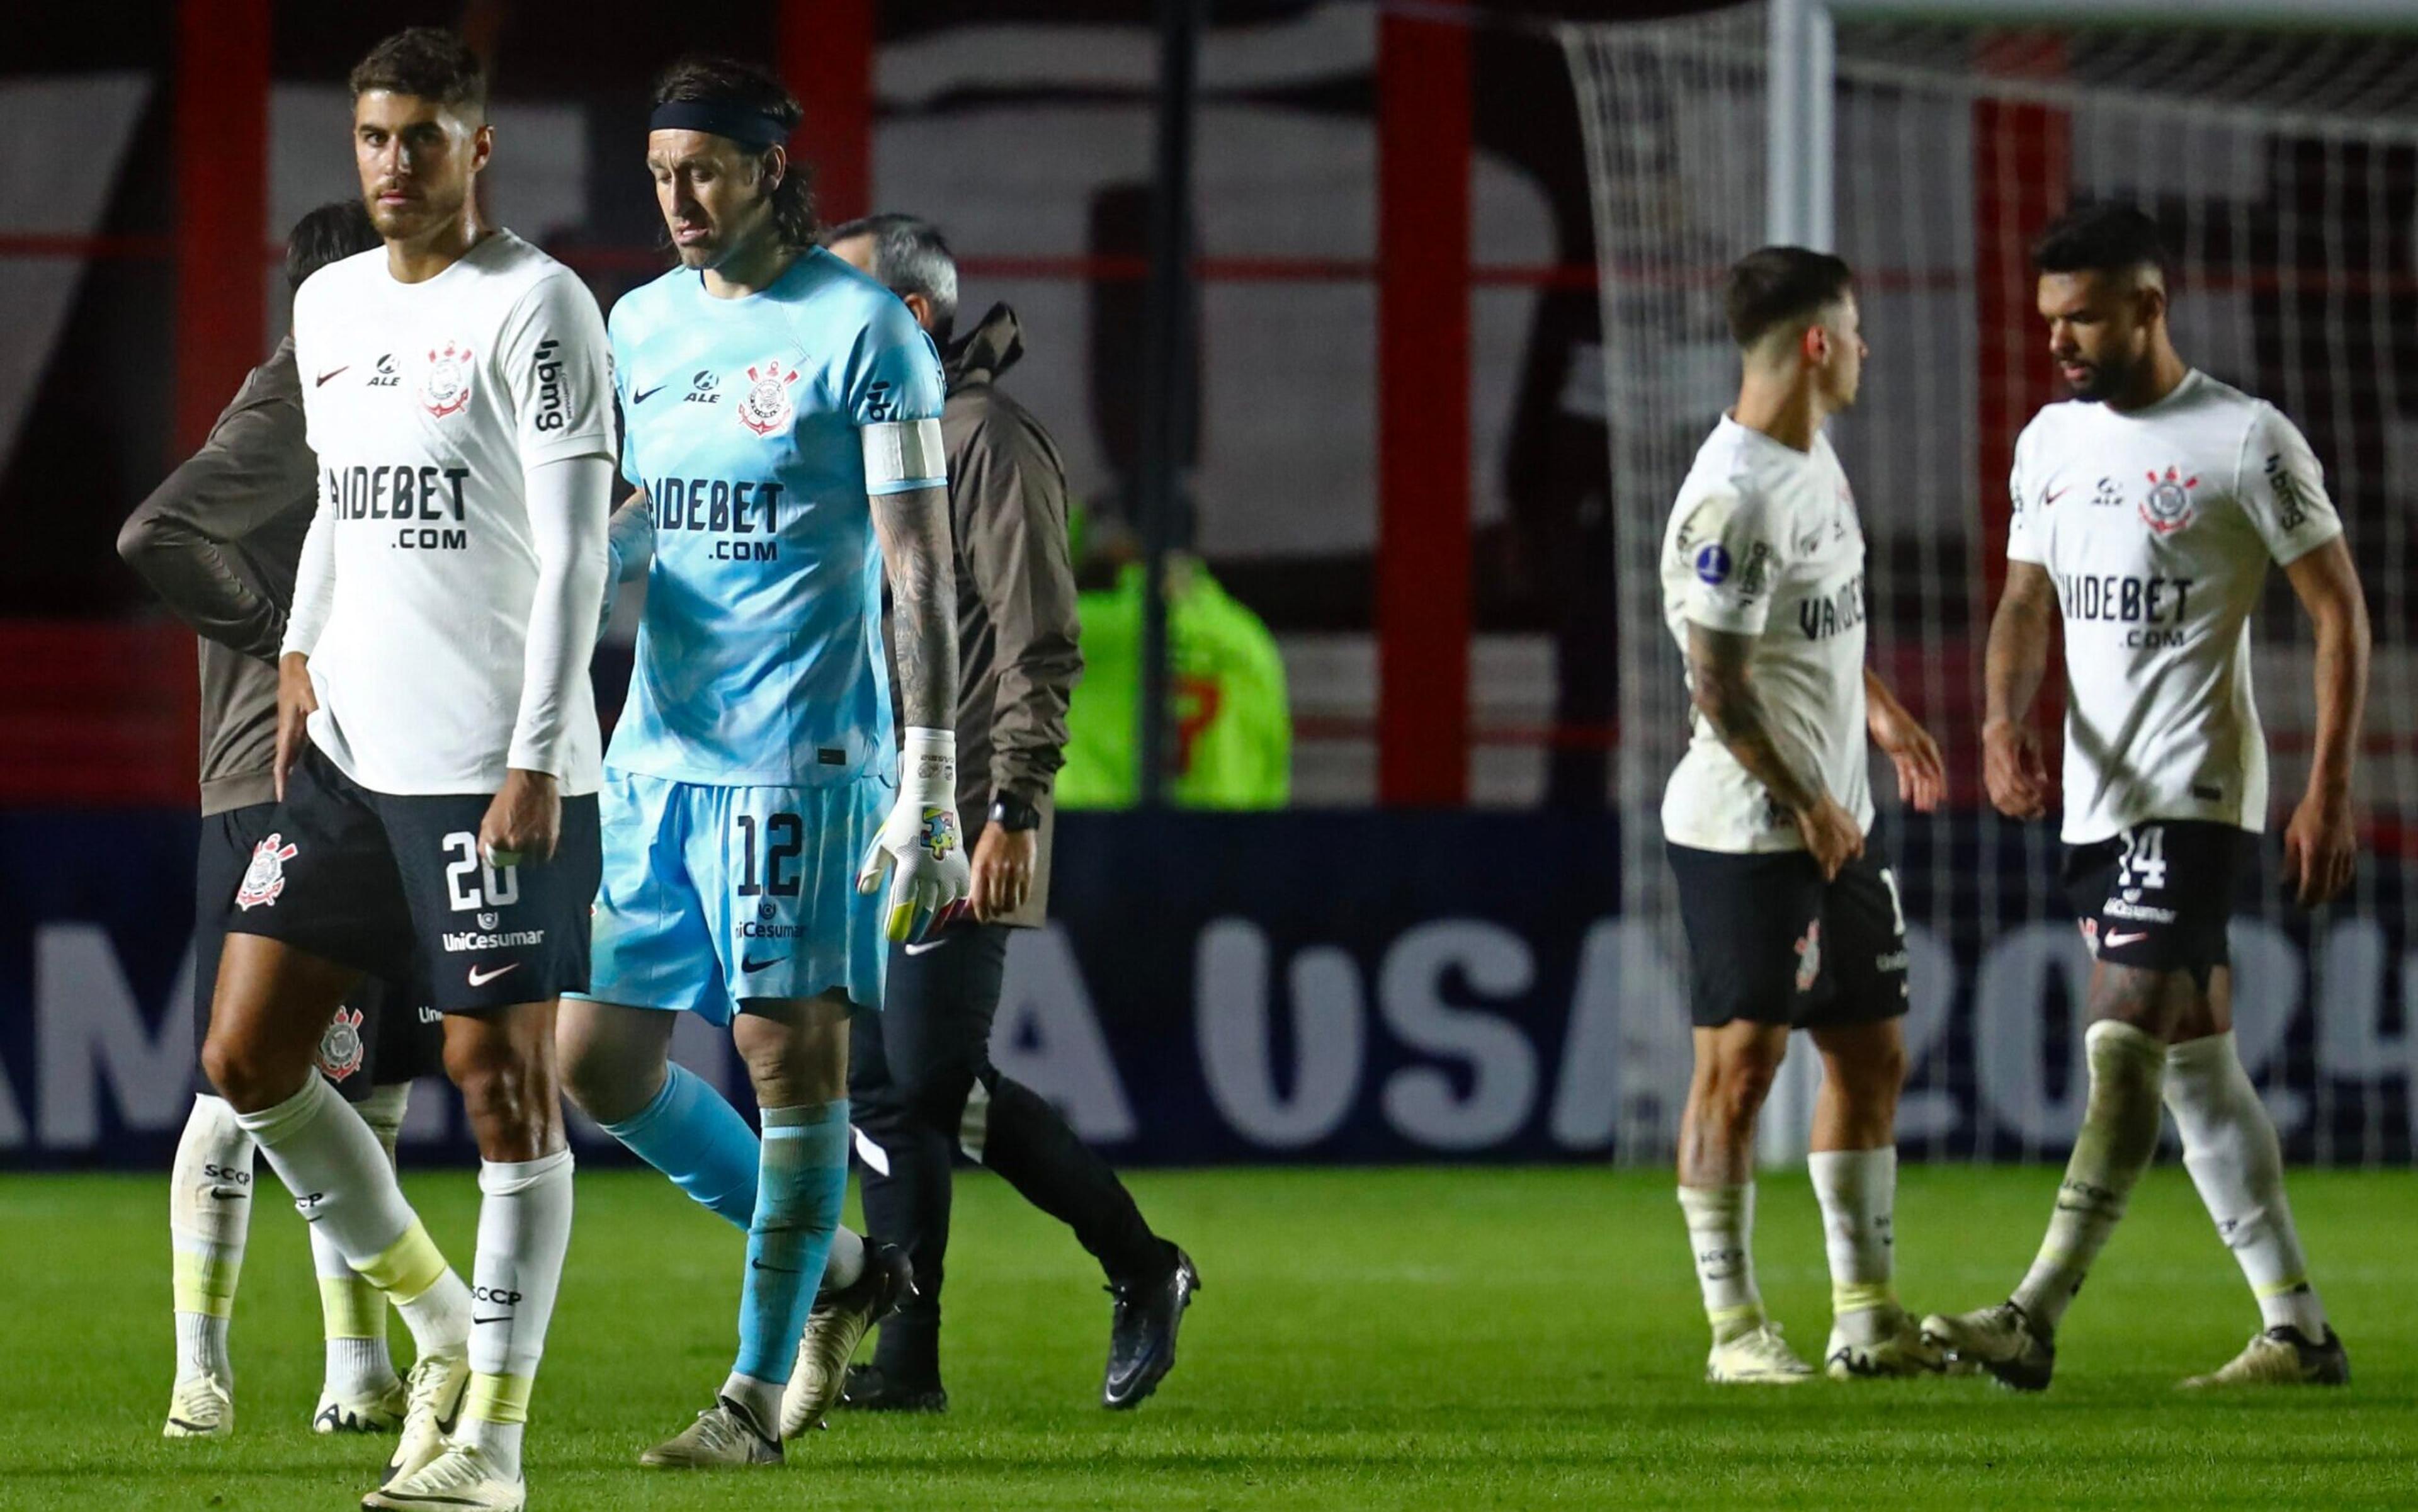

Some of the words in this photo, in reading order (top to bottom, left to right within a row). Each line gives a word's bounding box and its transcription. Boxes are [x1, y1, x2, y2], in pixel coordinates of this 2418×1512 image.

[367, 377, 400, 387] ALE
[535, 361, 564, 431] bmg
[683, 392, 721, 404] ALE
[325, 465, 470, 521] AIDEBET
[391, 528, 467, 550] .COM
[708, 540, 778, 561] .COM
[2118, 631, 2185, 649] .COM
[737, 813, 803, 897] 12
[442, 831, 519, 911] 20
[442, 929, 545, 952] UniCesumar
[204, 1164, 251, 1186] SCCP
